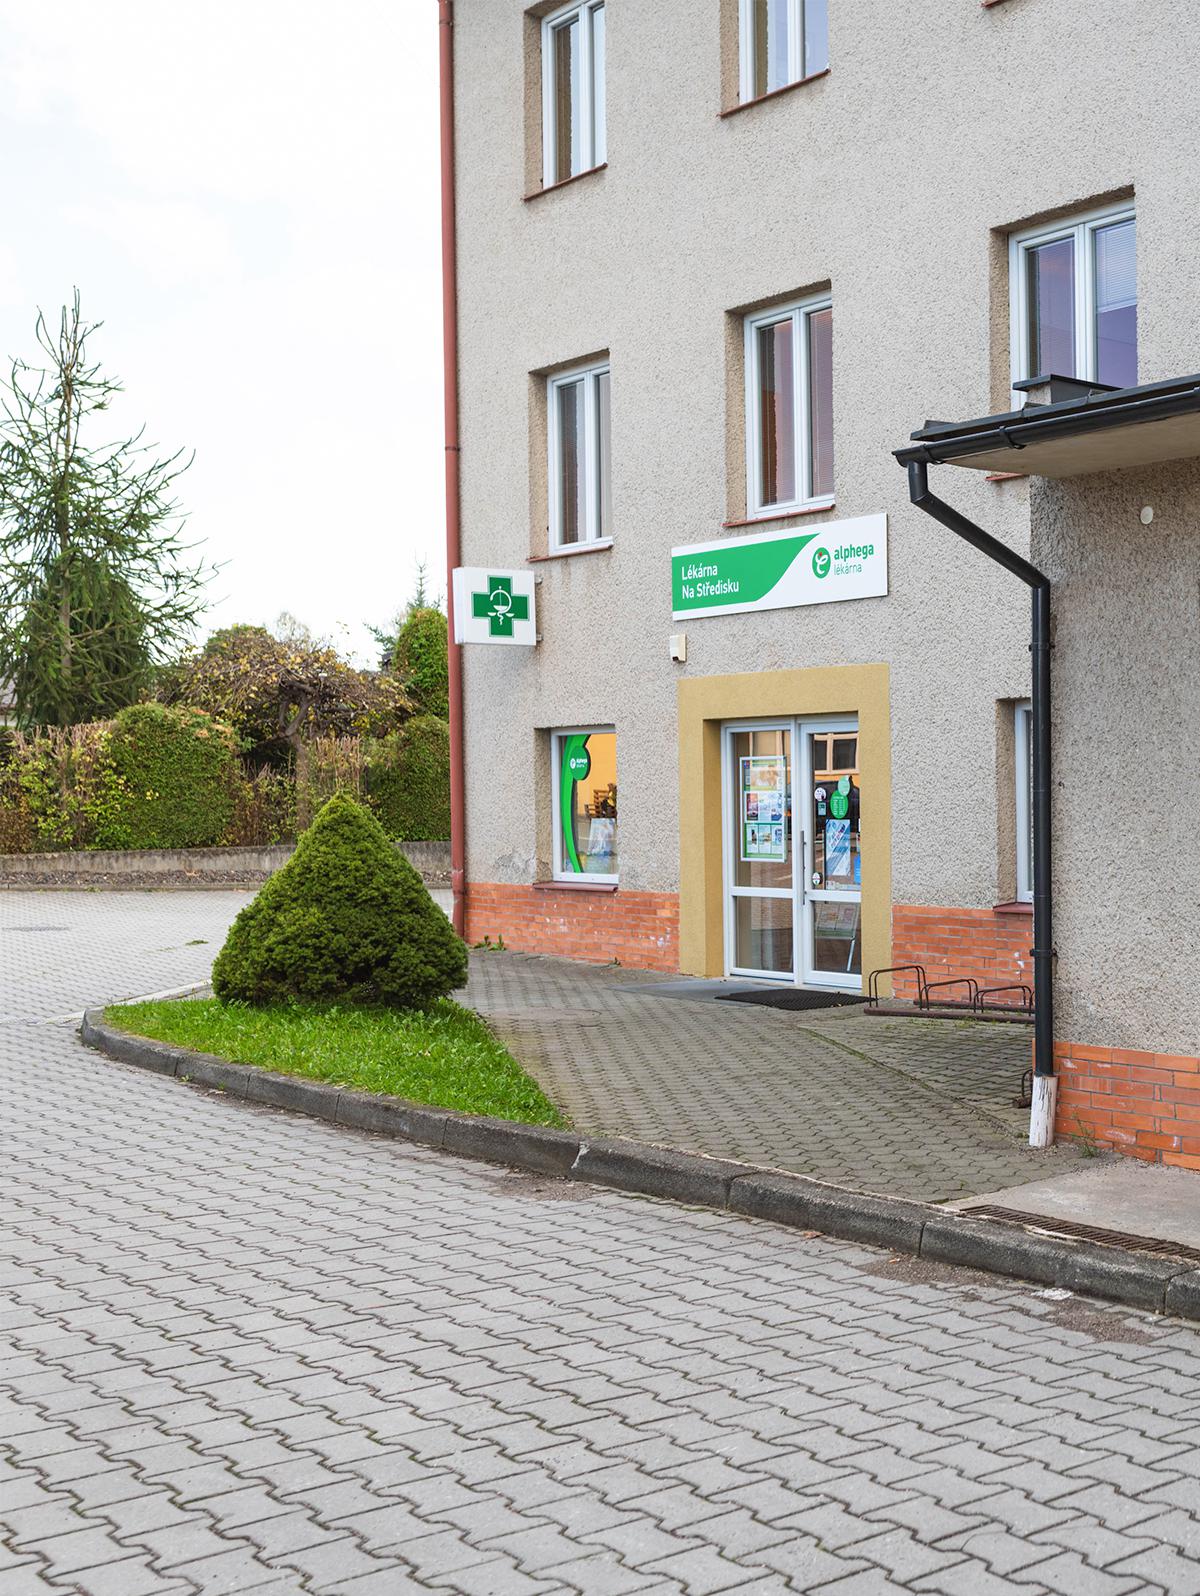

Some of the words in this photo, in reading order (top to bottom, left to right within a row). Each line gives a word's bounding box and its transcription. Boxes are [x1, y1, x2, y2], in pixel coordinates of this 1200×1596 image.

[834, 543, 874, 562] alphega
[682, 564, 718, 580] Lékárna
[834, 562, 862, 576] lékárna
[682, 585, 694, 599] Na
[697, 579, 739, 597] Středisku
